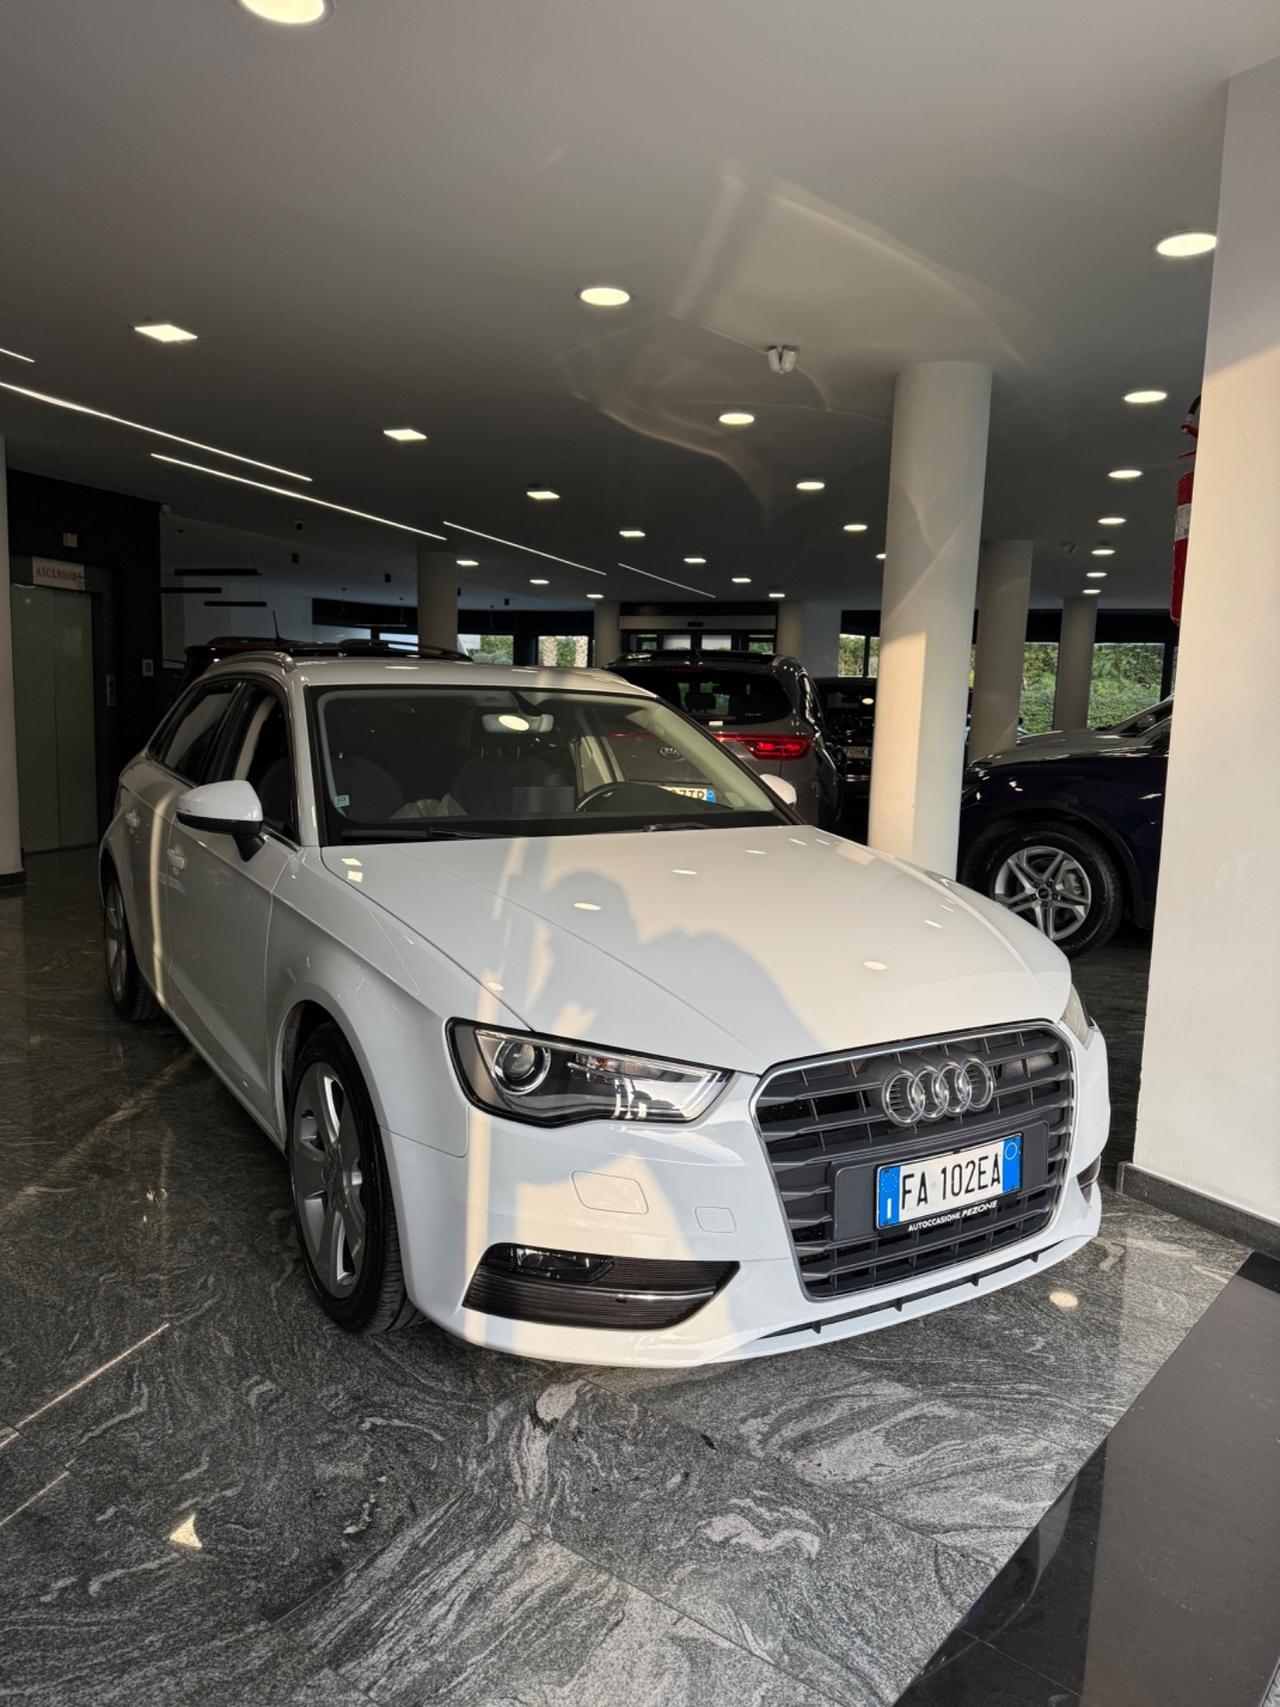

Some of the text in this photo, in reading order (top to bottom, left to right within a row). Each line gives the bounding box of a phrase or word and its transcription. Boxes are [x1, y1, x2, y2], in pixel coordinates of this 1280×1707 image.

[902, 1153, 1001, 1210] FA 102EA
[908, 1212, 961, 1232] AUTOCCASIONE
